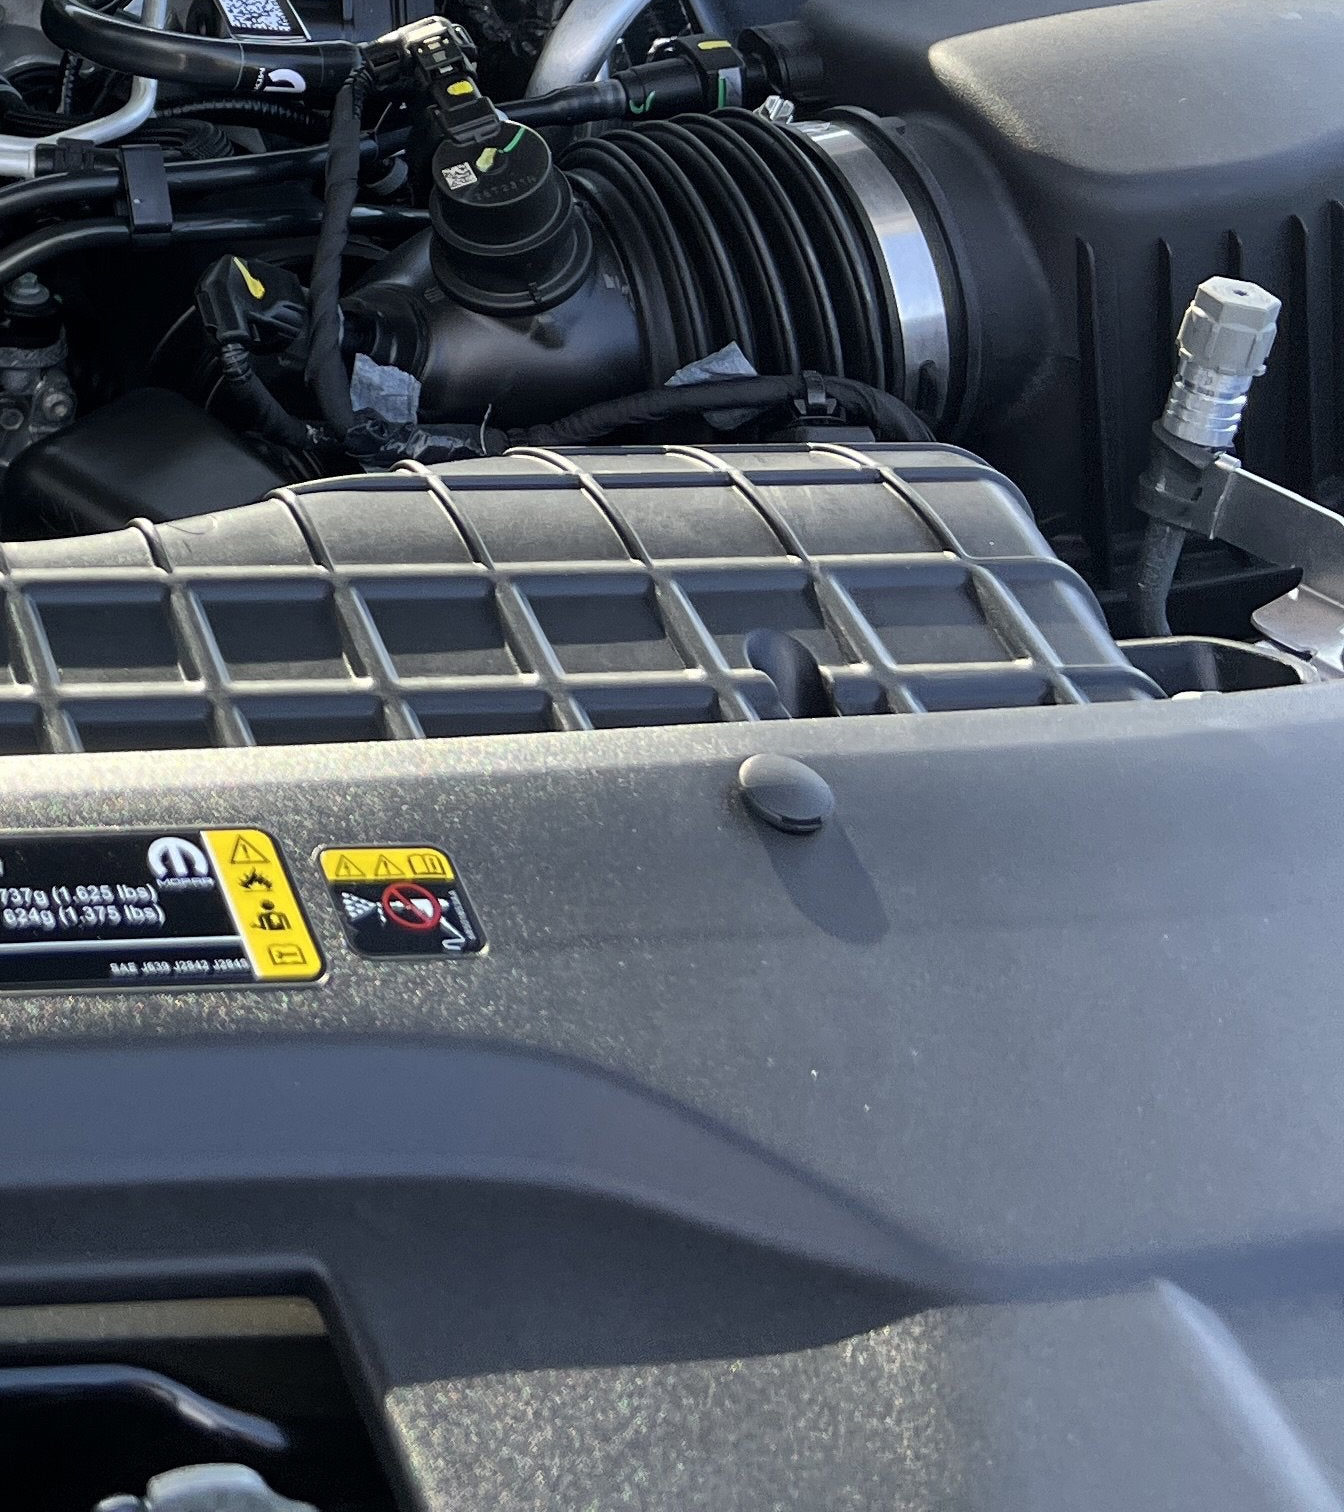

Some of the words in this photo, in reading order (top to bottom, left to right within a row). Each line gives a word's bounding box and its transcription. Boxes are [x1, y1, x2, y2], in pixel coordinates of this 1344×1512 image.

[52, 885, 115, 905] (1.625
[116, 882, 159, 904] lbs)
[2, 907, 57, 931] 624g
[59, 905, 122, 927] (1.375
[123, 903, 167, 926] lbs)
